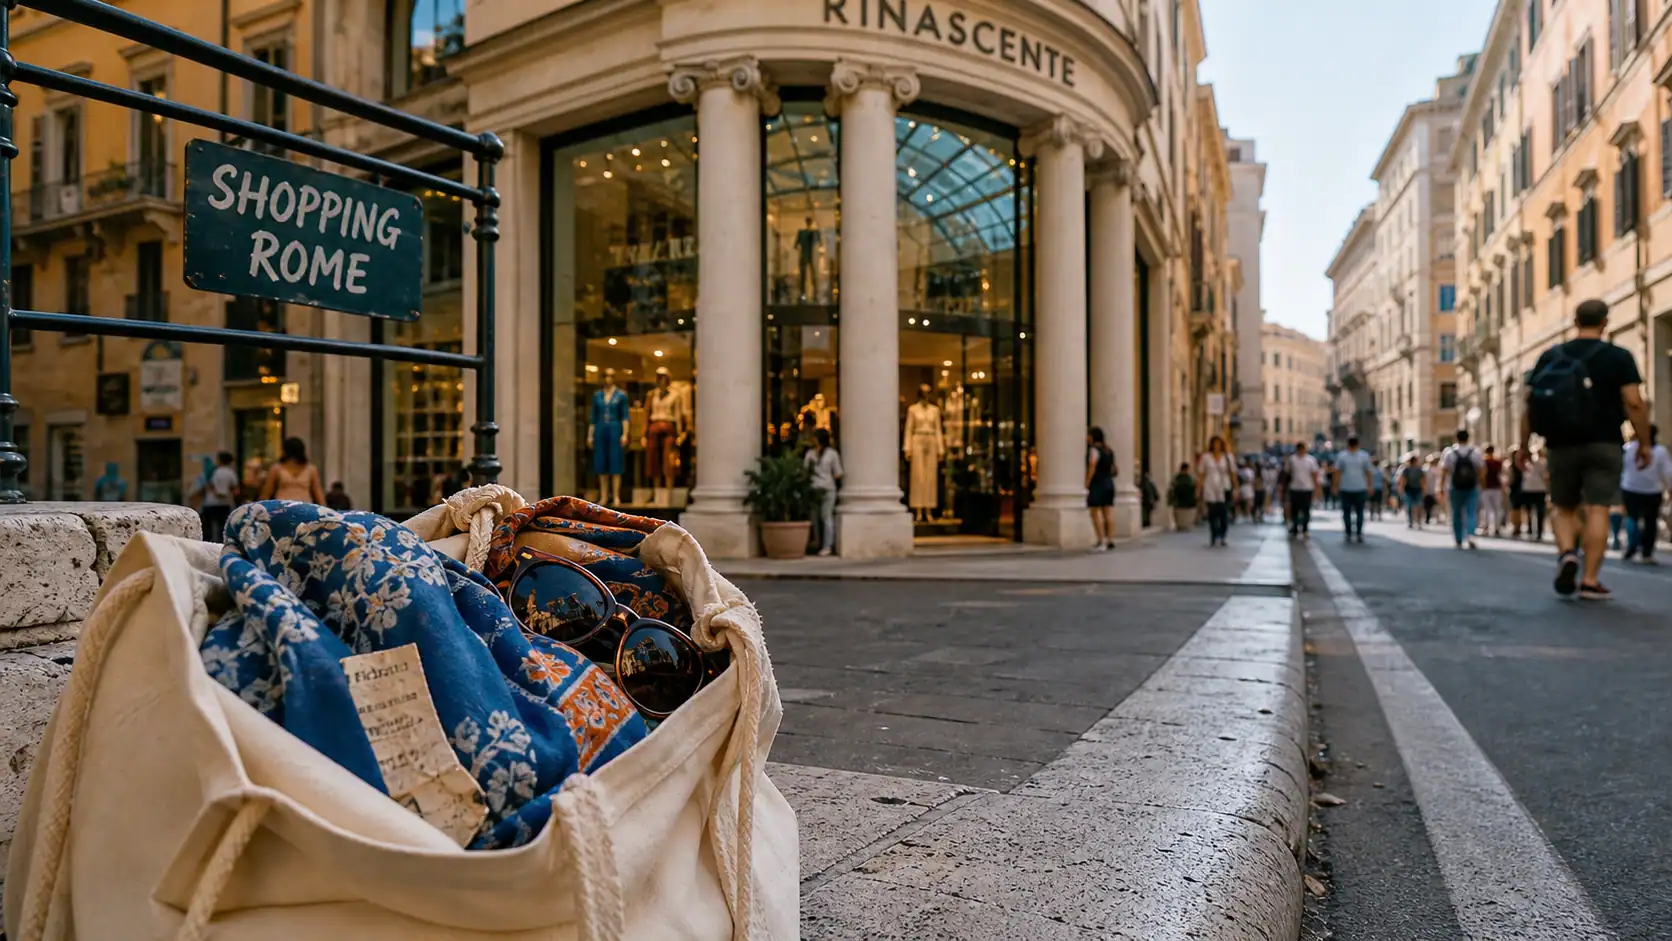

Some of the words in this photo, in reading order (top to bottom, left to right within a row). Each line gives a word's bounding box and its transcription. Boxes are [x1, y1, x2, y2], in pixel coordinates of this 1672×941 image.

[823, 0, 1076, 88] RINASCENTE
[208, 164, 401, 250] SHOPPING
[250, 230, 370, 294] ROME
